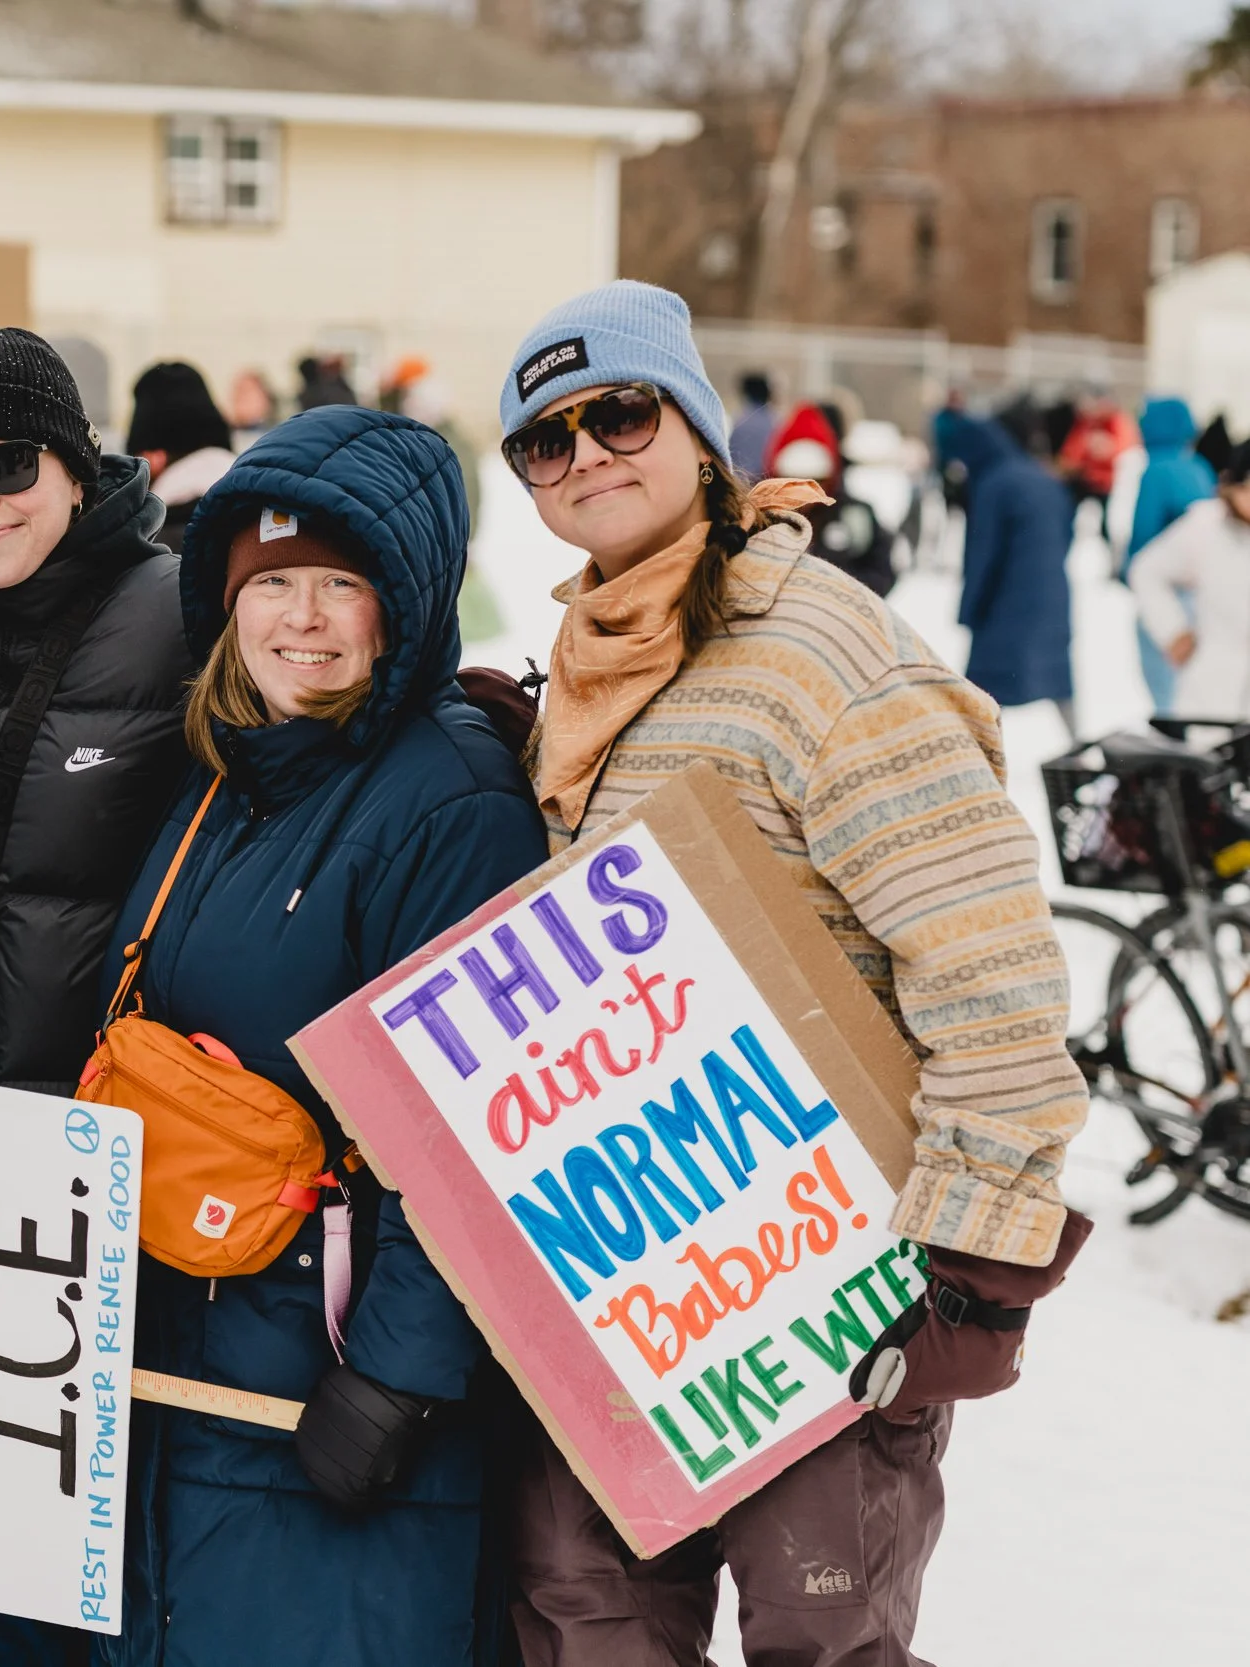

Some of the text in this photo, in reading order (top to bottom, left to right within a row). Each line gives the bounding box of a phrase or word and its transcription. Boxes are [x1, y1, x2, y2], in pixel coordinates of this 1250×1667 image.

[522, 352, 577, 390] NATIVE LAND
[523, 345, 575, 379] YOU ARE ON
[71, 746, 104, 763] NIKE
[382, 844, 668, 1080] THIS
[487, 963, 696, 1155] ain't
[506, 1023, 839, 1302] NORMAL
[593, 1144, 868, 1380] Babes!
[80, 1135, 132, 1623] REST IN POWER RENEE GOOD
[649, 1335, 807, 1484] LIKE
[820, 1574, 852, 1589] REI
